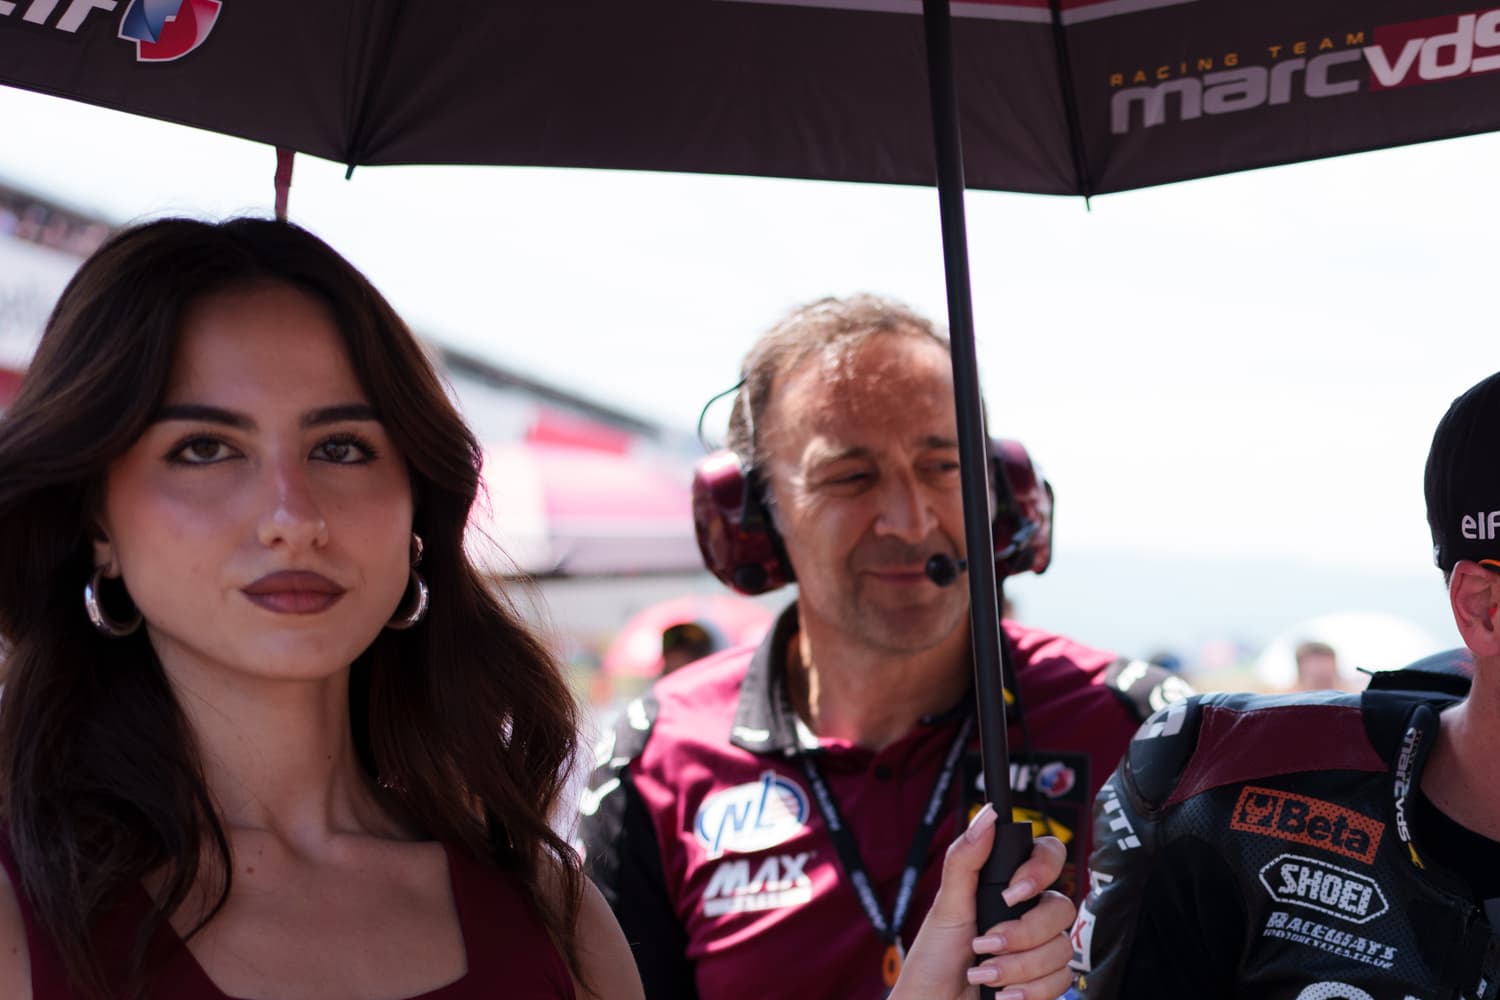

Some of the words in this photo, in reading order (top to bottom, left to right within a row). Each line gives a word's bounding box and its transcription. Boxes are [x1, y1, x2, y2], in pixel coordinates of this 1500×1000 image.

[1110, 53, 1239, 87] RACING
[1270, 31, 1366, 58] TEAM
[1277, 799, 1370, 855] Beta
[703, 853, 808, 898] MAX
[1278, 864, 1373, 916] SHOEI
